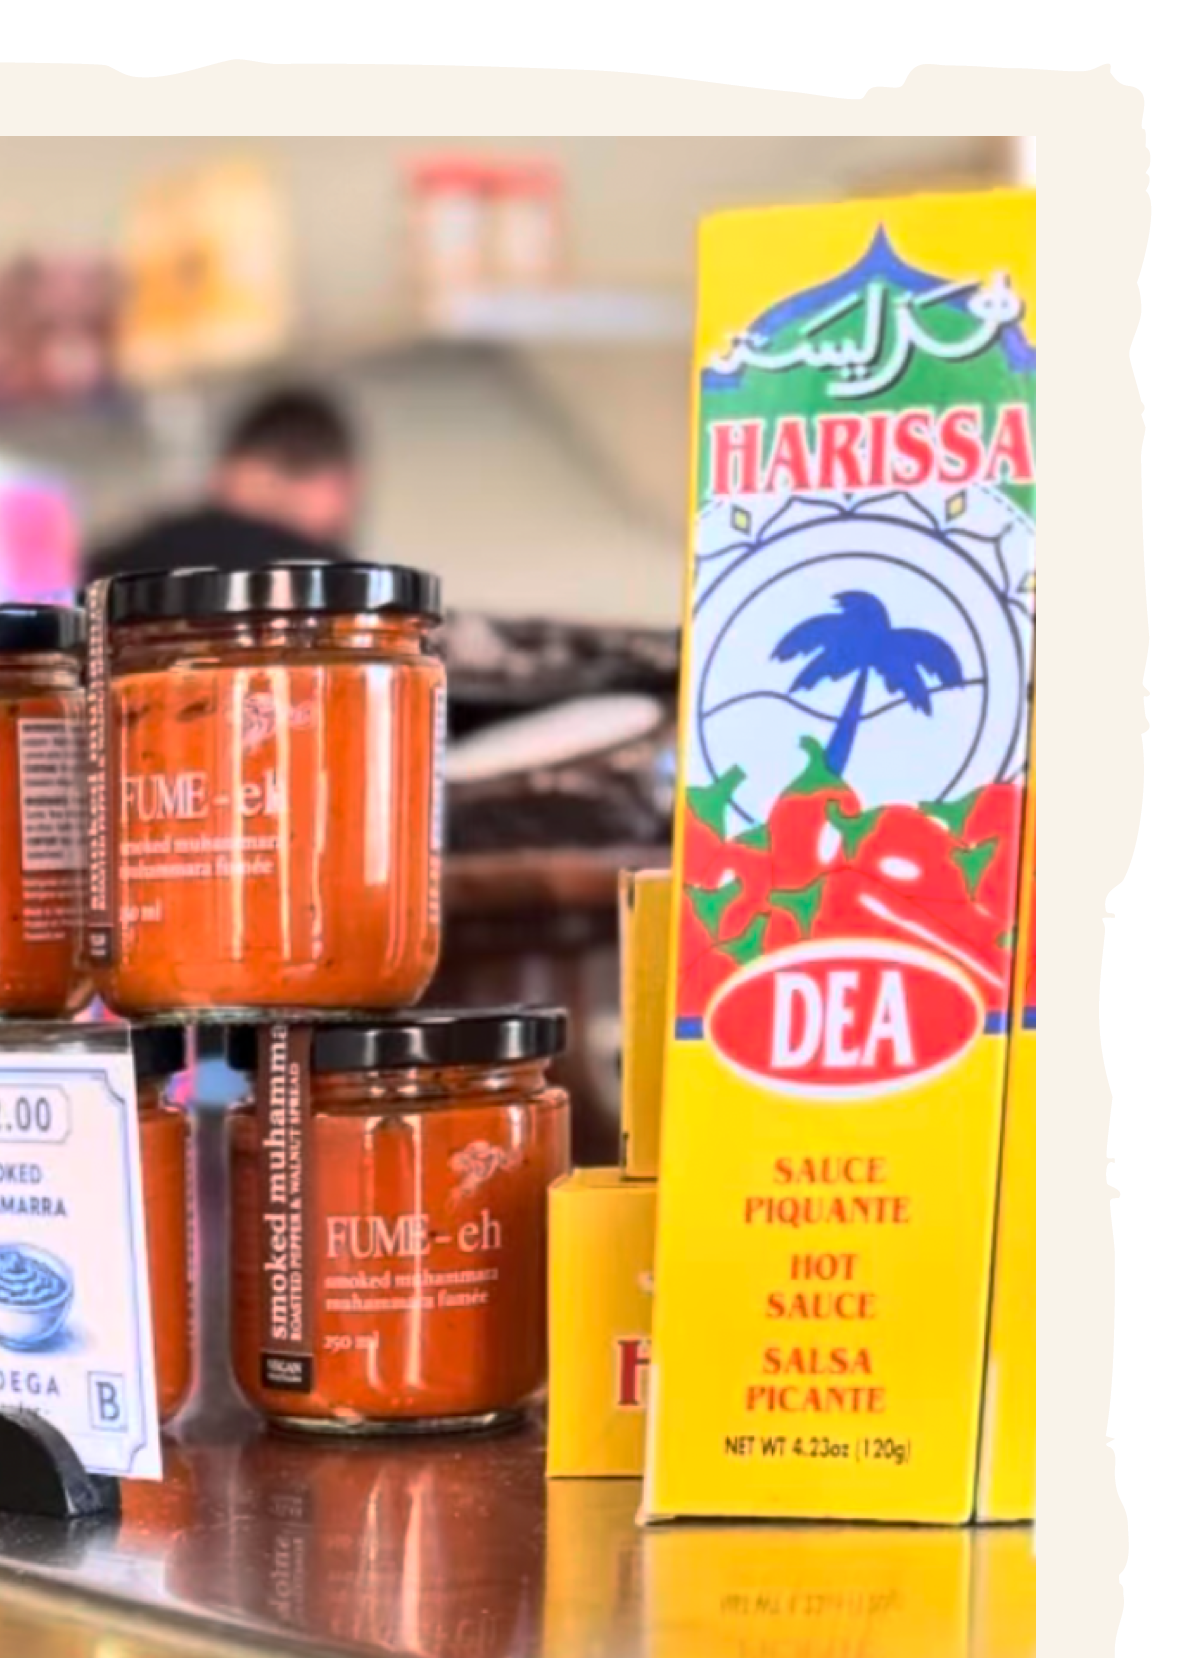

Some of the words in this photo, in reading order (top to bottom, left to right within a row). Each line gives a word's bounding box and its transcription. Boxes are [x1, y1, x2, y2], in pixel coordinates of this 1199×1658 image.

[708, 403, 1035, 496] HARISSA
[770, 970, 917, 1070] DEA
[773, 1156, 887, 1185] SAUCE
[744, 1196, 910, 1229] PIQUANTE
[264, 1214, 287, 1340] smoked
[325, 1269, 391, 1289] smoked
[789, 1253, 859, 1281] HOT
[766, 1291, 877, 1319] SAUCE
[762, 1346, 874, 1375] SALSA
[96, 1381, 121, 1421] B
[745, 1386, 886, 1414] PICANTE
[725, 1435, 755, 1454] NET
[761, 1436, 786, 1456] WT
[792, 1436, 850, 1458] 4.23oz
[856, 1437, 911, 1464] (120g)
